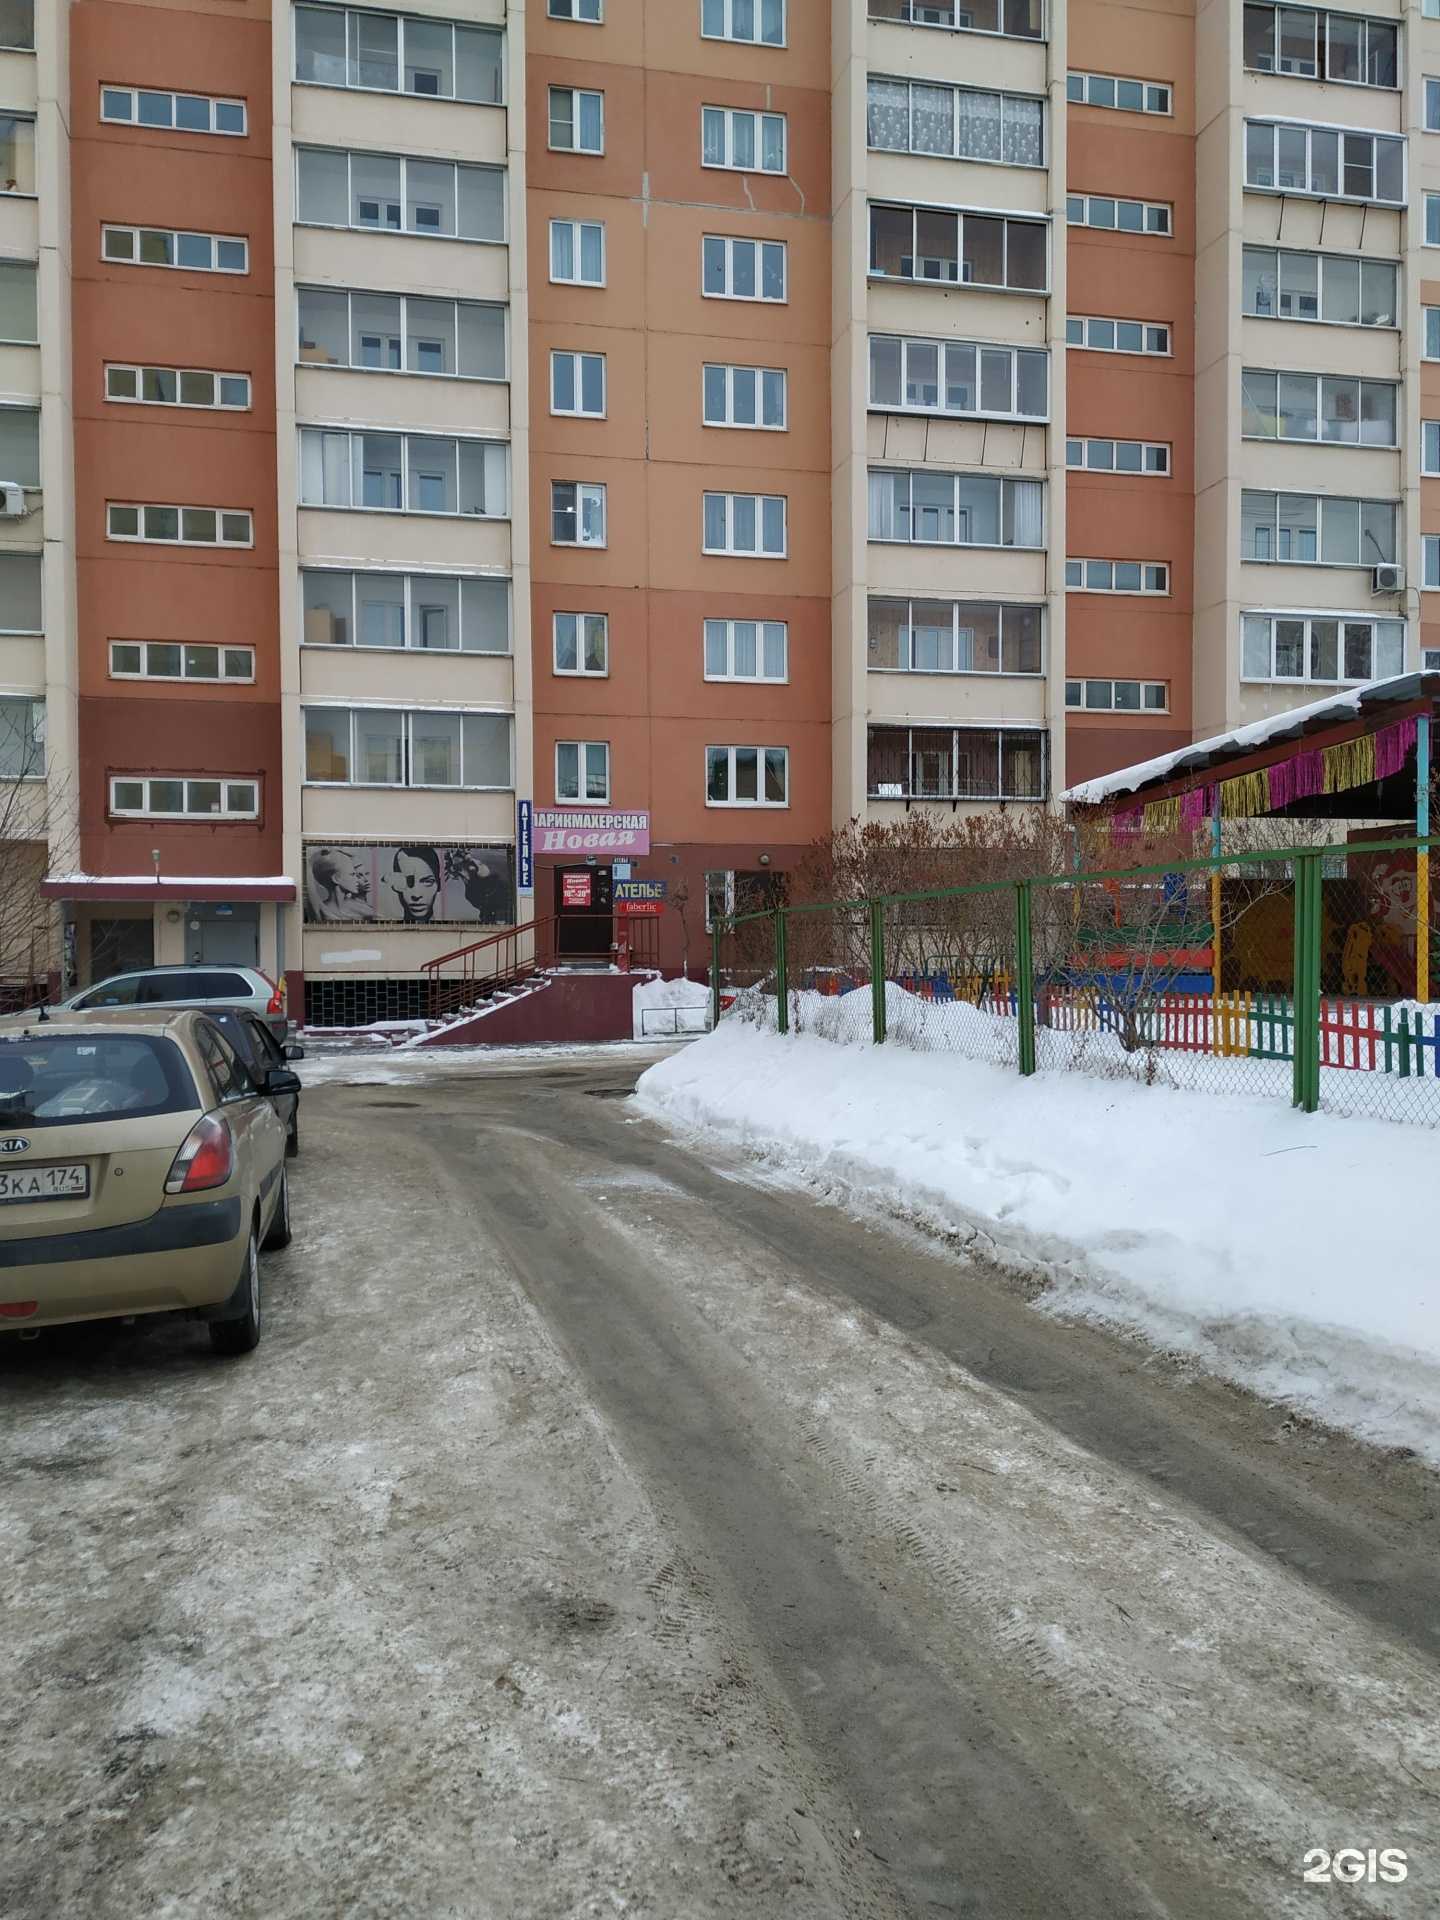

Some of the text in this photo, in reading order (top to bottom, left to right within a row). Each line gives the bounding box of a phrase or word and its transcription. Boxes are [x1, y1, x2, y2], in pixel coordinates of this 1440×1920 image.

[521, 803, 529, 886] АТЕЛЬЕ
[542, 830, 636, 851] Новая
[615, 883, 662, 898] АТЕЛЬЕ
[626, 902, 657, 911] faberlic
[0, 1140, 23, 1150] KIA
[46, 1168, 79, 1186] 174
